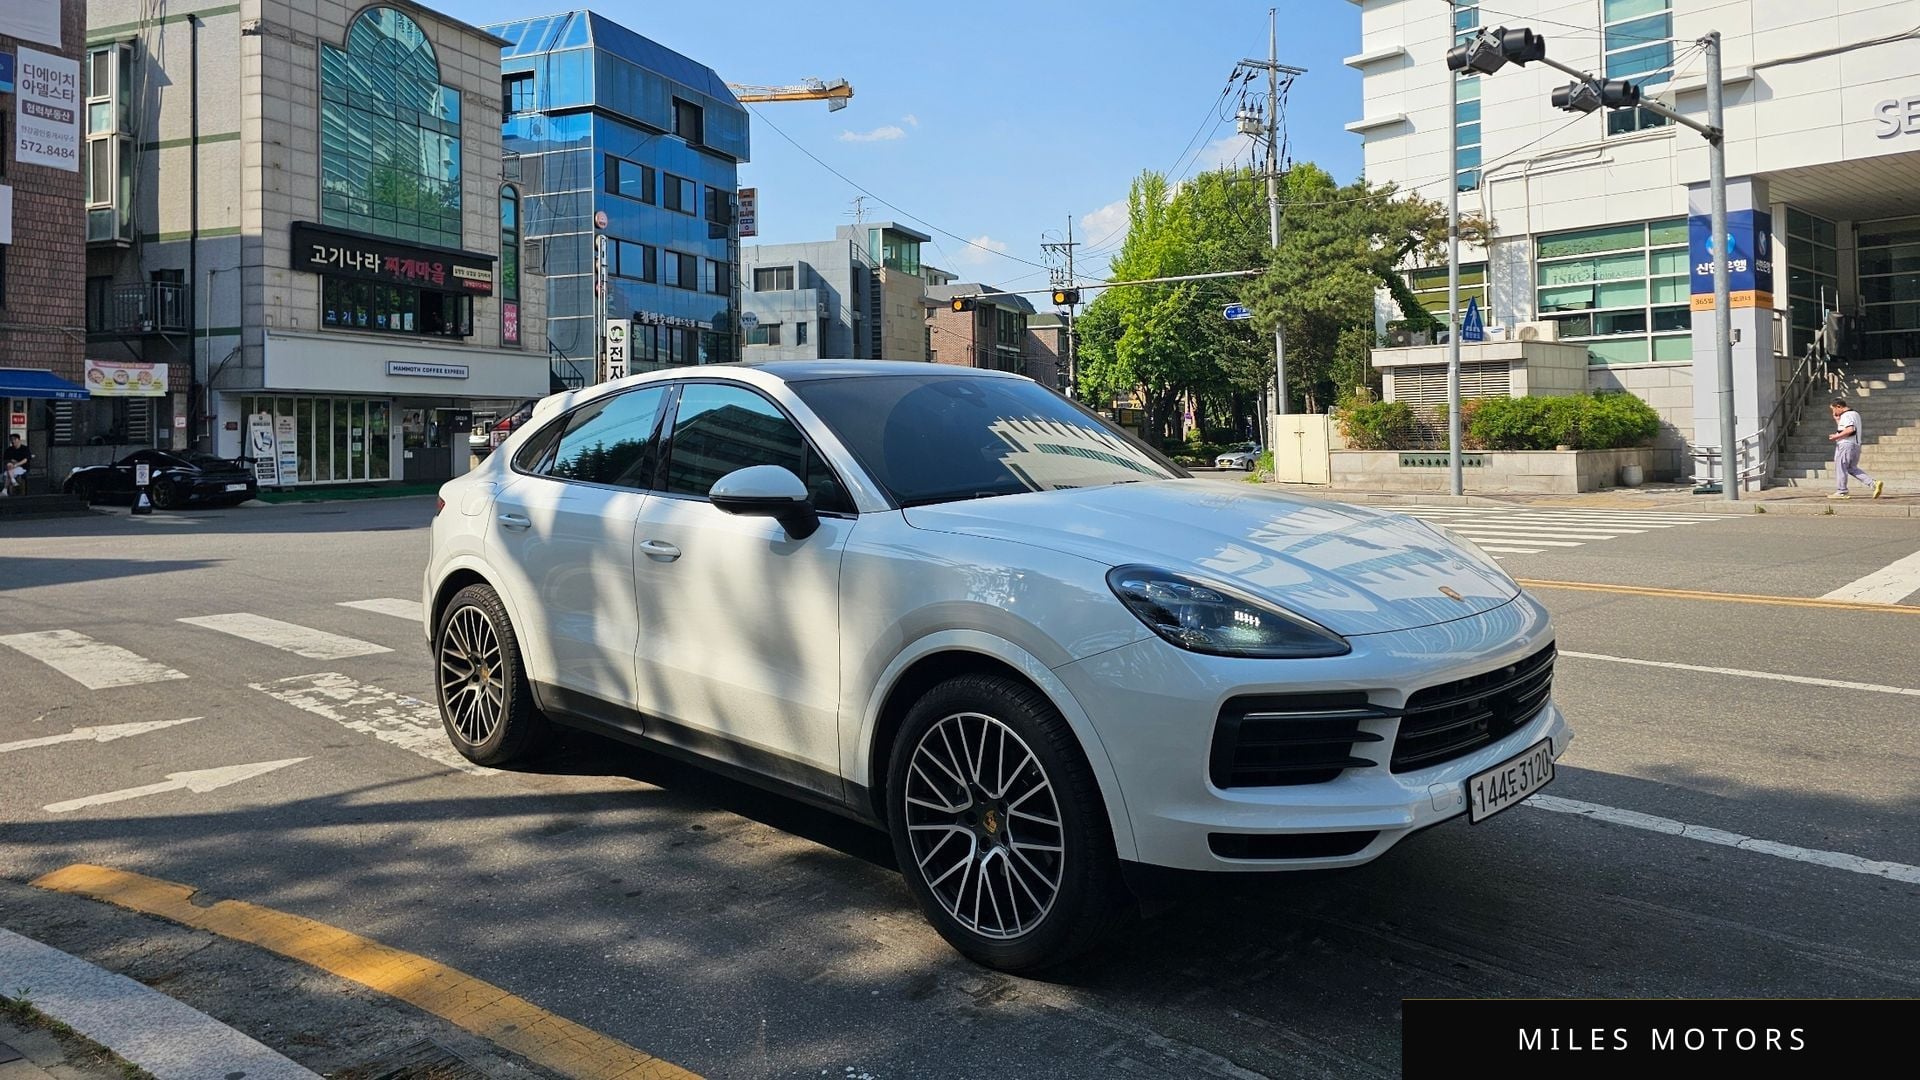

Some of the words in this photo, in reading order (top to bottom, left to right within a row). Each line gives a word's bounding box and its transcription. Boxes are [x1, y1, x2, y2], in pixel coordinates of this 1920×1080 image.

[23, 63, 75, 88] 디에이치
[22, 79, 75, 103] 아델스타
[26, 103, 70, 121] 협력부동산
[20, 139, 75, 159] 572.8484
[311, 245, 381, 273] 고기나라
[384, 256, 446, 286] 찌개마을
[393, 365, 421, 373] MAMMOTH
